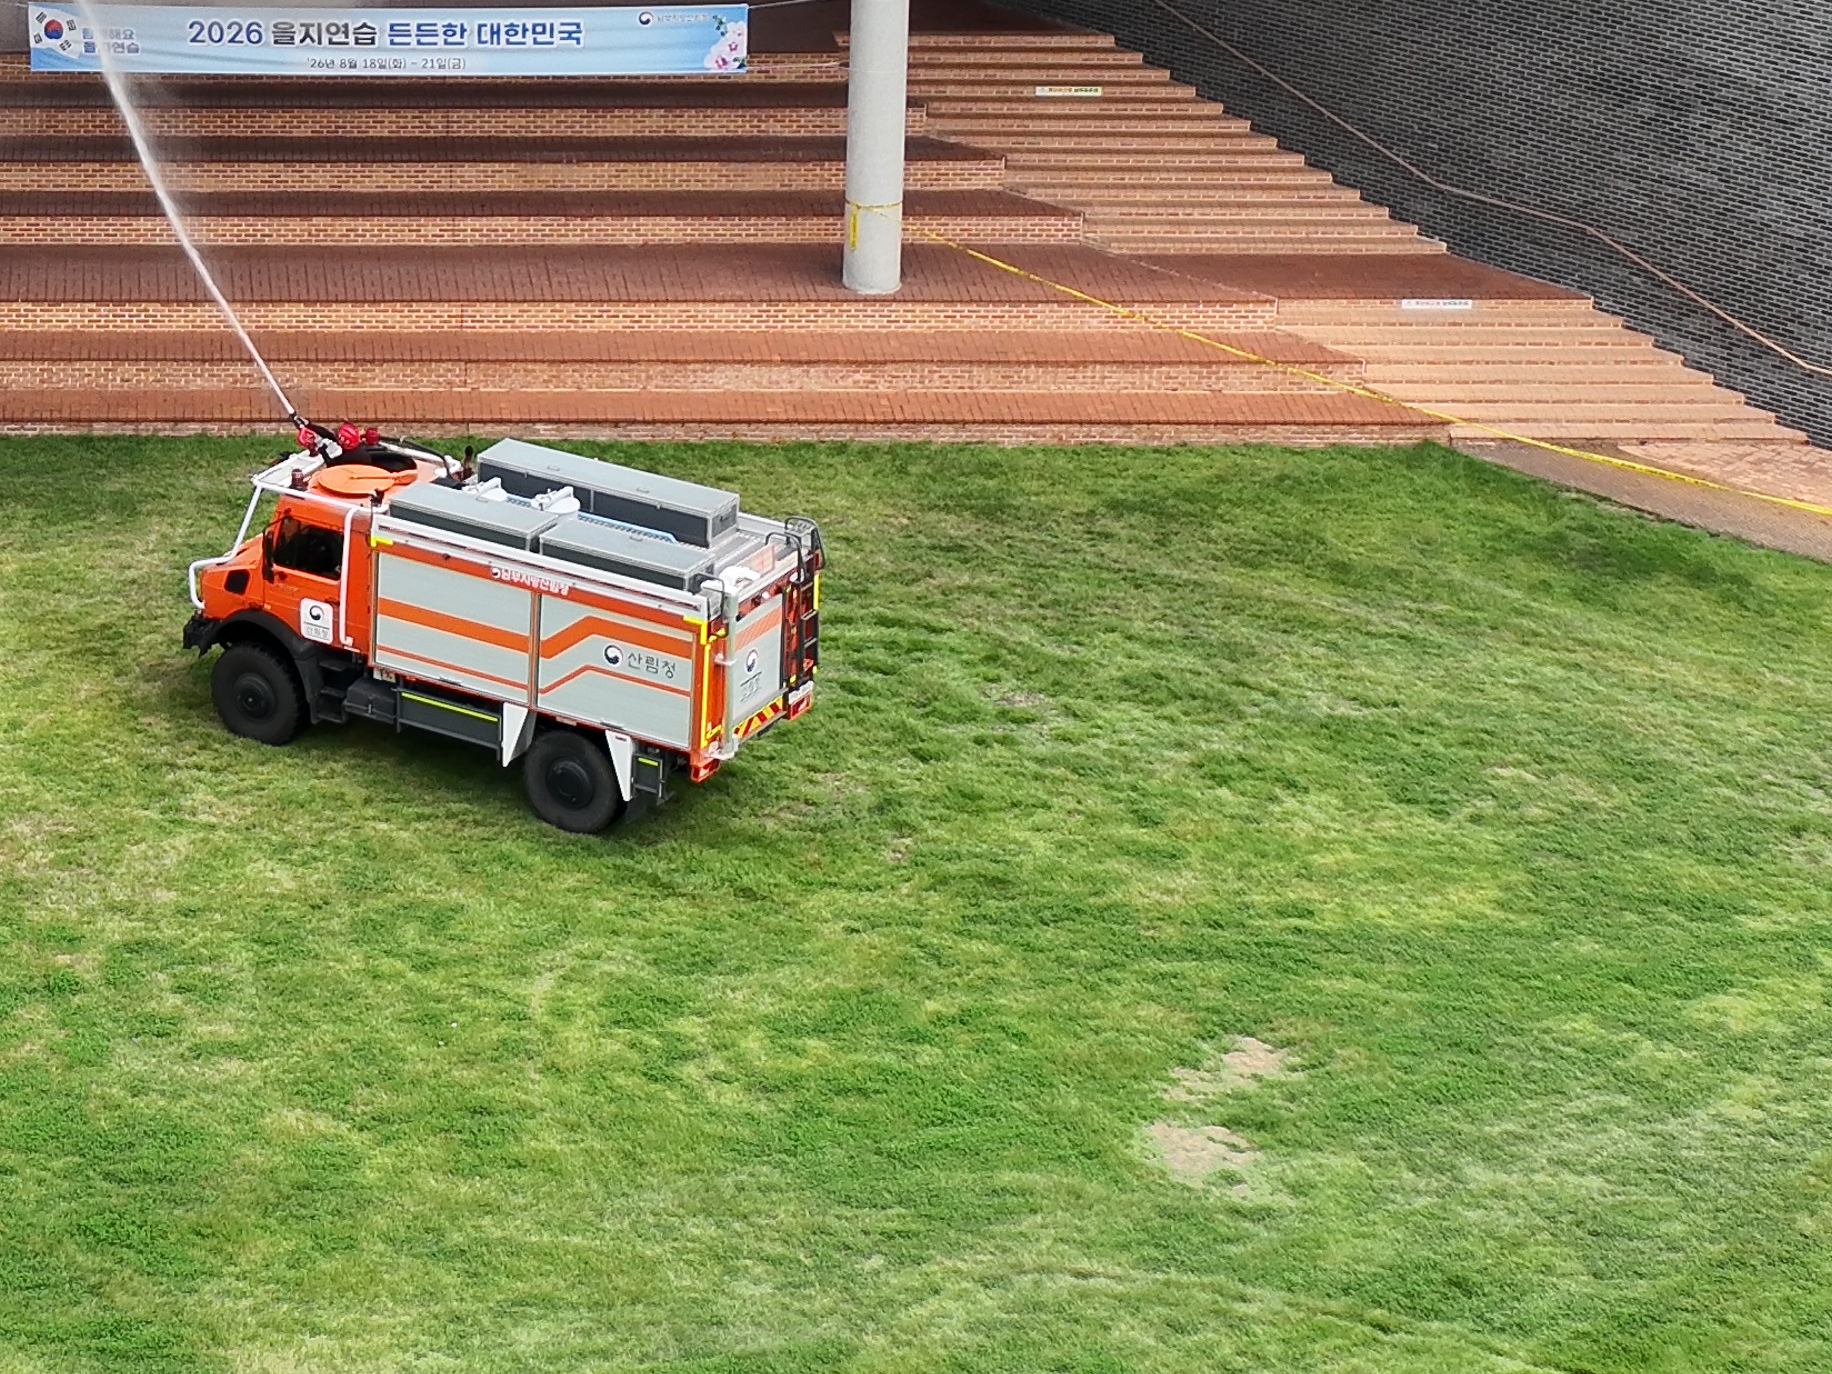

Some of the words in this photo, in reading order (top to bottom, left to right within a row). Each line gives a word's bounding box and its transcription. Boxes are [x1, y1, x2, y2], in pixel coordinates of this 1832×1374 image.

[188, 20, 264, 45] 2026
[272, 21, 378, 46] 을지연습
[387, 22, 468, 46] 든든한
[476, 21, 583, 46] 대한민국
[307, 57, 336, 70] '26년
[339, 58, 358, 70] 8월
[363, 57, 407, 70] 18일(화)
[421, 57, 466, 70] 21일(금)
[627, 652, 677, 680] 산림청
